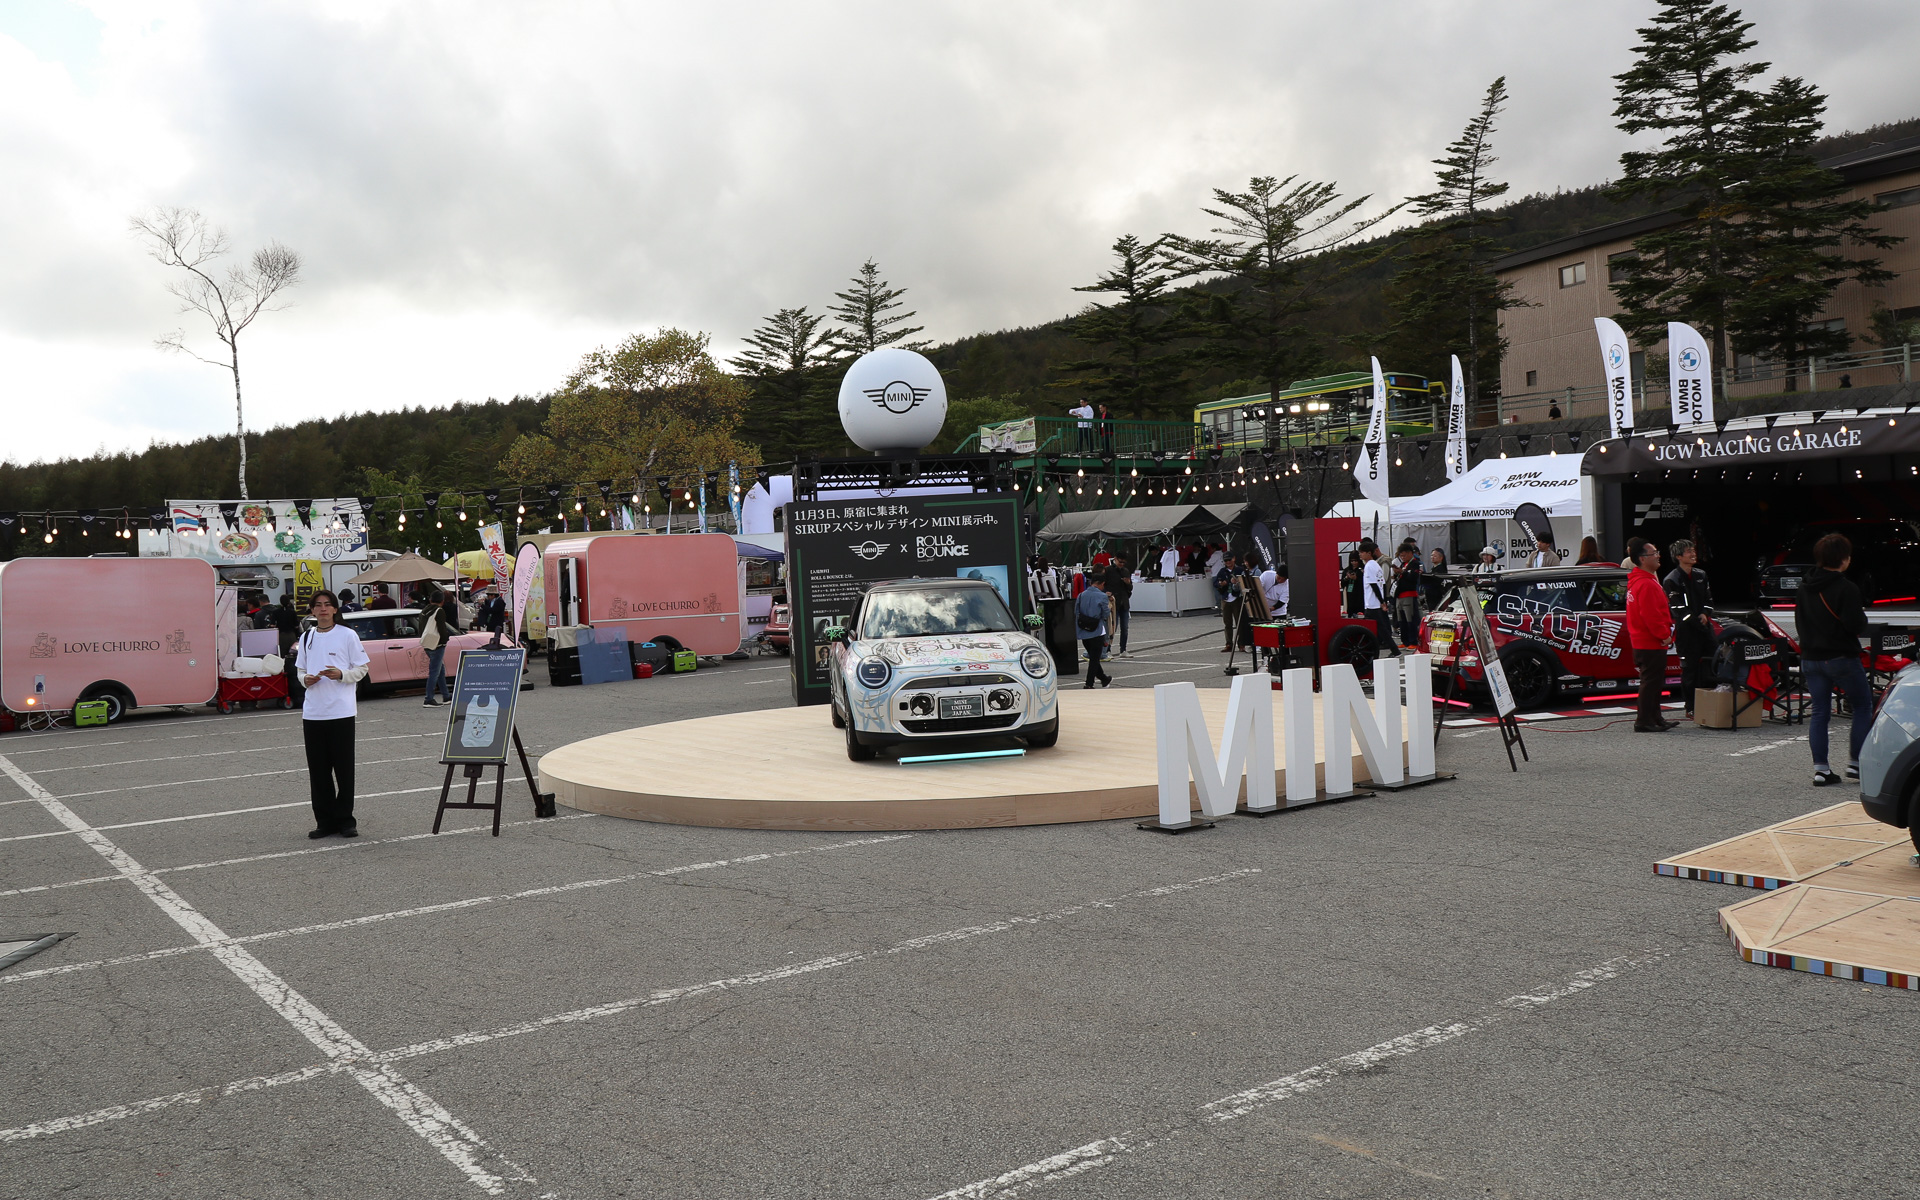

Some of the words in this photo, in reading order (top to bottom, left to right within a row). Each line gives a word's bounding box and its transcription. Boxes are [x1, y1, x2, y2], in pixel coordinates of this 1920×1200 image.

[886, 392, 912, 402] MINI
[1655, 443, 1694, 461] JCW
[1699, 437, 1771, 458] RACING
[1777, 429, 1862, 452] GARAGE
[1506, 471, 1543, 482] BMW
[1499, 478, 1579, 491] MOTORRAD
[794, 504, 909, 521] 11月3日、原宿に集まれ
[862, 546, 877, 554] MINI
[916, 545, 970, 559] BOUNCE
[518, 592, 527, 614] LOVE
[524, 556, 538, 591] CHURRO
[1547, 581, 1577, 589] YUZUKI
[631, 602, 658, 613] LOVE
[658, 599, 700, 611] CHURRO
[1513, 629, 1534, 640] Sanyo
[1533, 634, 1548, 644] Cars
[1547, 638, 1567, 650] Group
[1881, 634, 1910, 647] SYCG
[64, 642, 100, 654] LOVE
[102, 640, 160, 653] CHURRO
[904, 642, 1004, 655] BOUNCE
[1568, 639, 1622, 660] Racing
[1744, 644, 1772, 657] SYCG
[488, 653, 506, 662] Stamp
[506, 653, 522, 662] Rally
[1154, 653, 1436, 826] MINI
